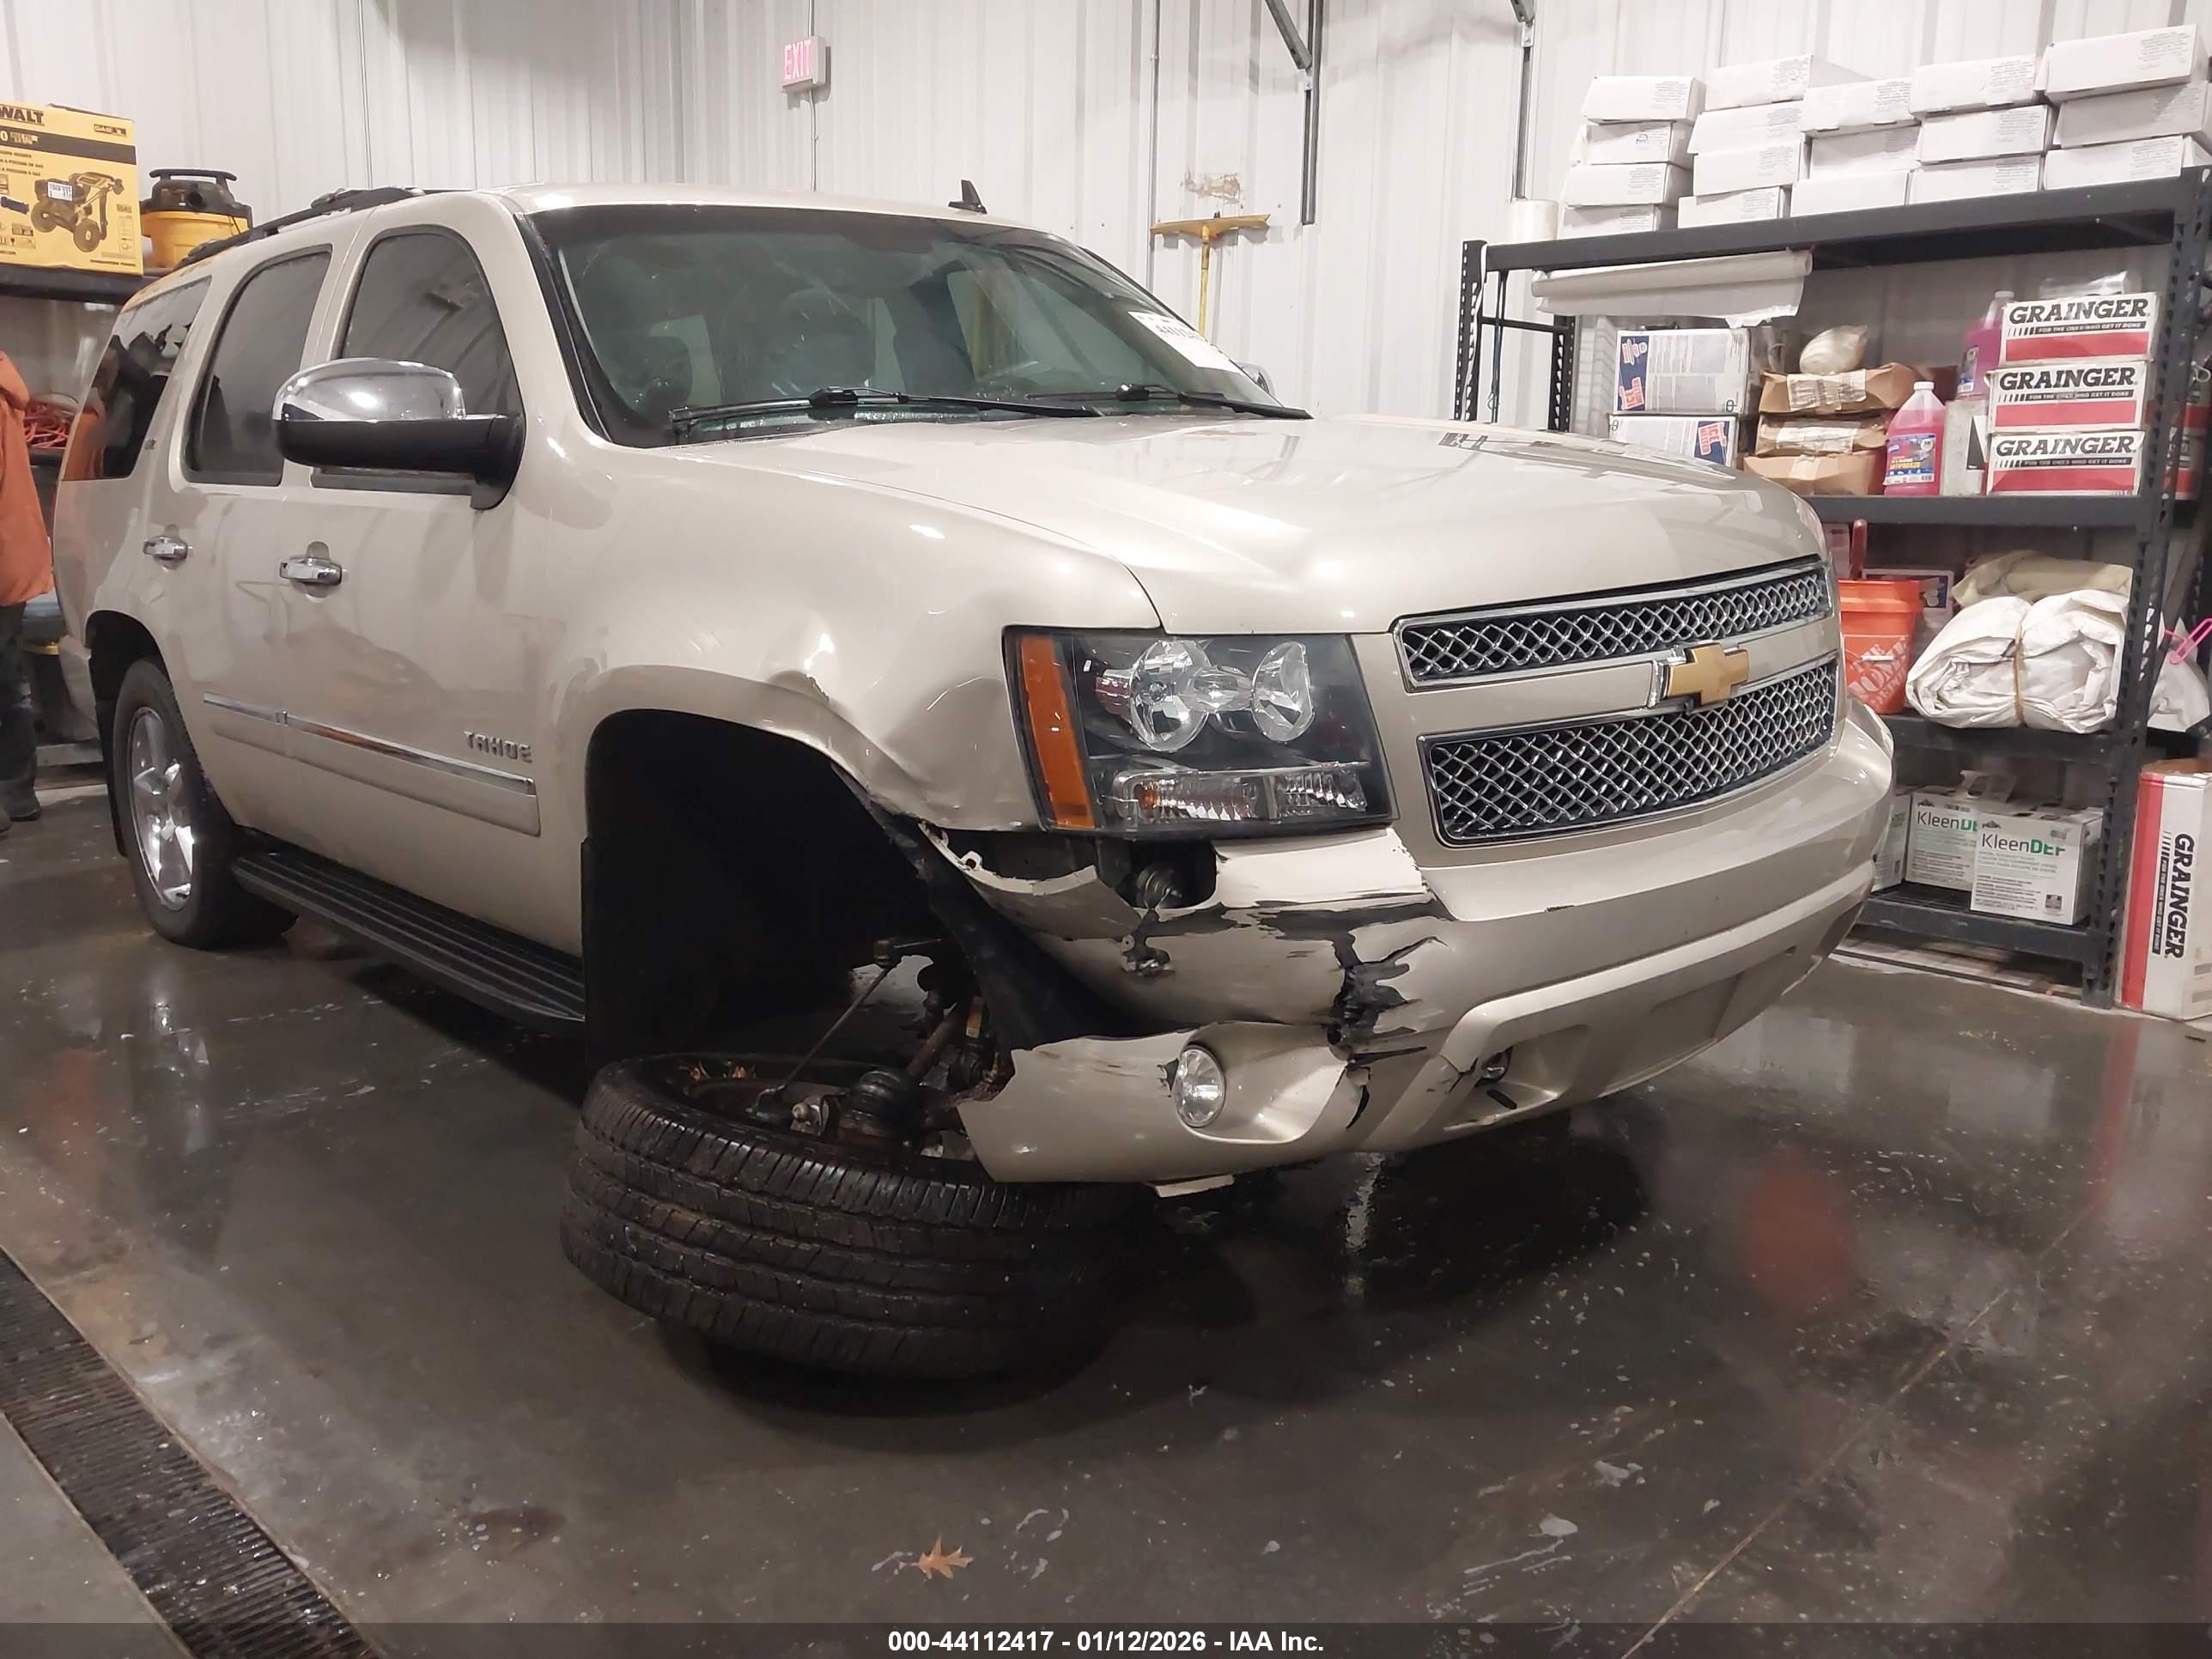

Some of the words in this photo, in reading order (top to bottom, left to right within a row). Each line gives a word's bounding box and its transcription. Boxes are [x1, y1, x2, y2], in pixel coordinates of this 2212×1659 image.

[783, 40, 811, 80] EXIT
[2009, 299, 2149, 325] GRAINGER
[1999, 367, 2136, 391] GRAINGER
[1996, 435, 2135, 457] GRAINGER
[464, 730, 532, 763] TAHOE
[2166, 833, 2195, 959] GRAINGER
